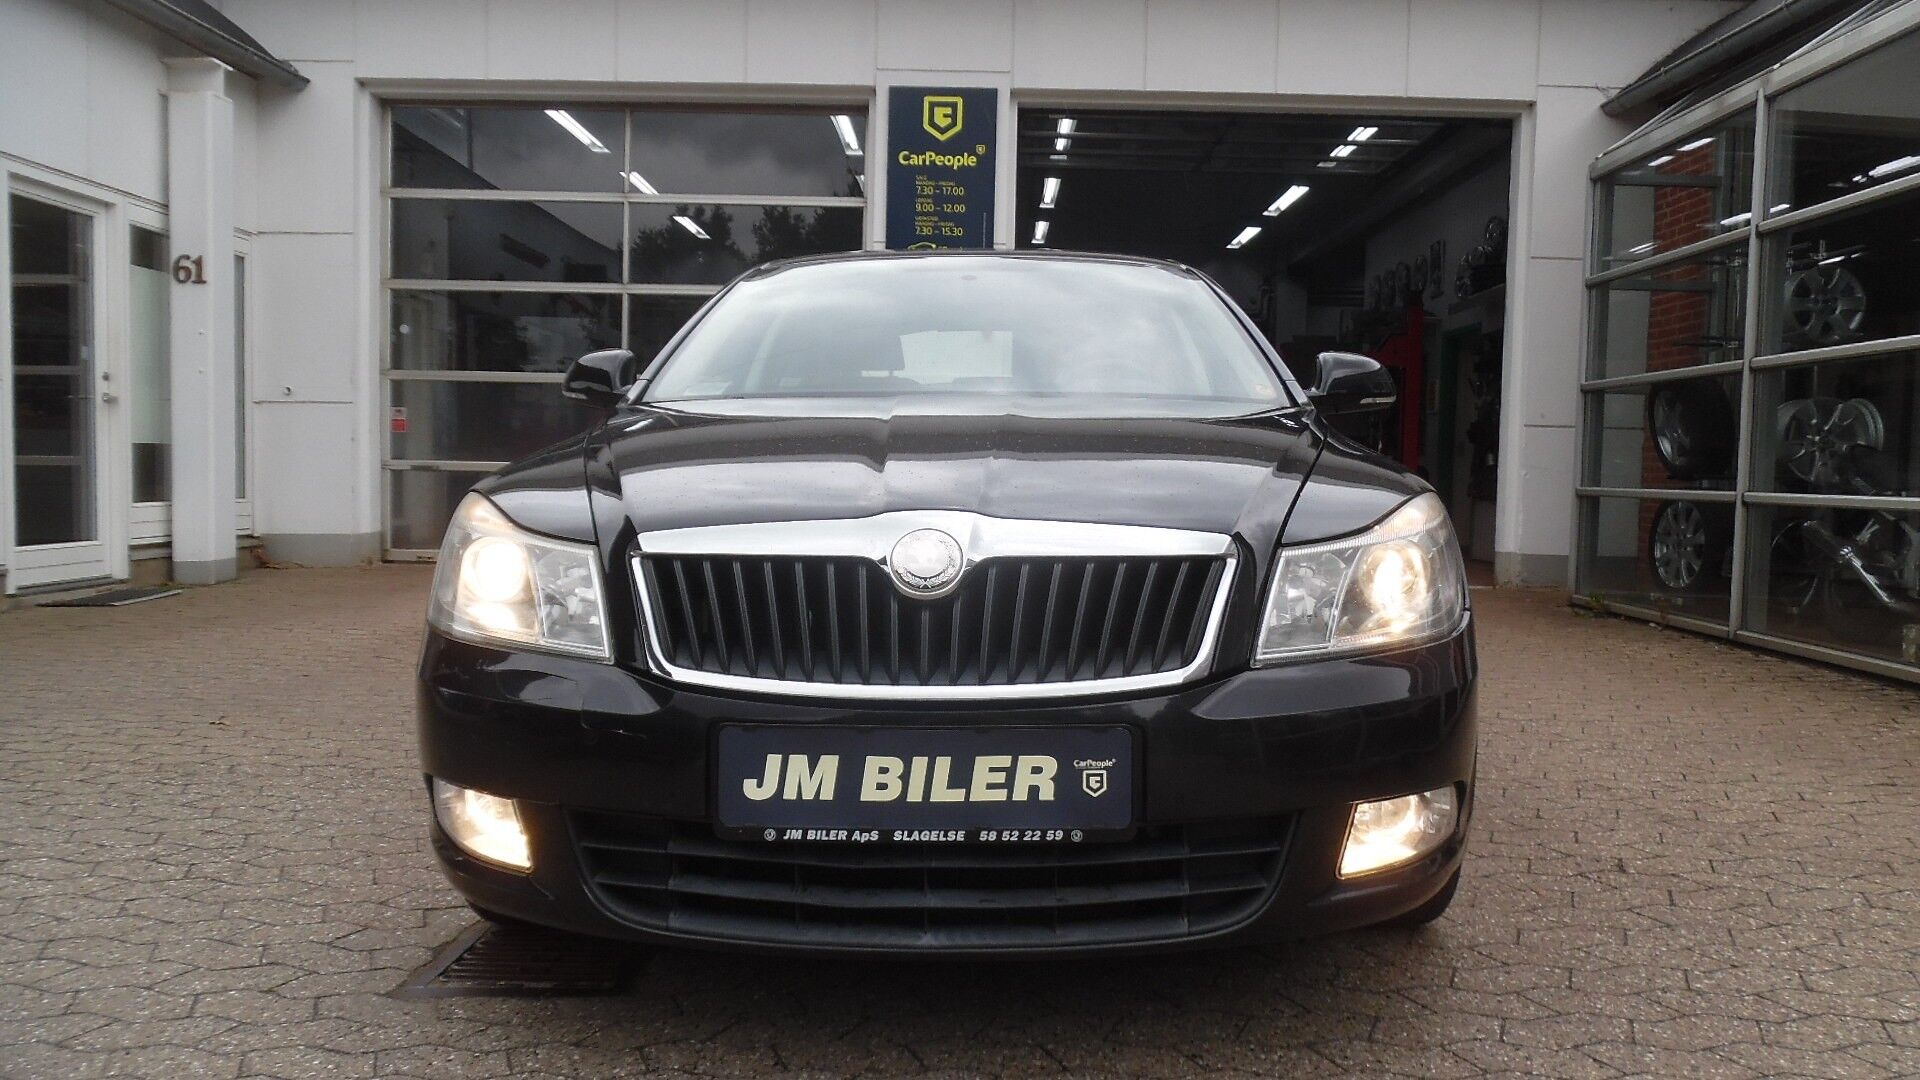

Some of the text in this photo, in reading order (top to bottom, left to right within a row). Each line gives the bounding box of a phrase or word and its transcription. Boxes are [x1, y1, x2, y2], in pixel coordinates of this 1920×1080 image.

[898, 150, 977, 170] CarPeople
[915, 185, 934, 195] 7.30
[942, 186, 965, 196] 17.00
[915, 203, 935, 212] 9.00
[943, 203, 966, 213] 12.00
[942, 227, 963, 236] 15.30
[172, 254, 207, 284] 61
[742, 753, 1058, 802] JM BILER
[783, 829, 1064, 843] JM BILER ApS SLAGELSE 58 52 22 59
